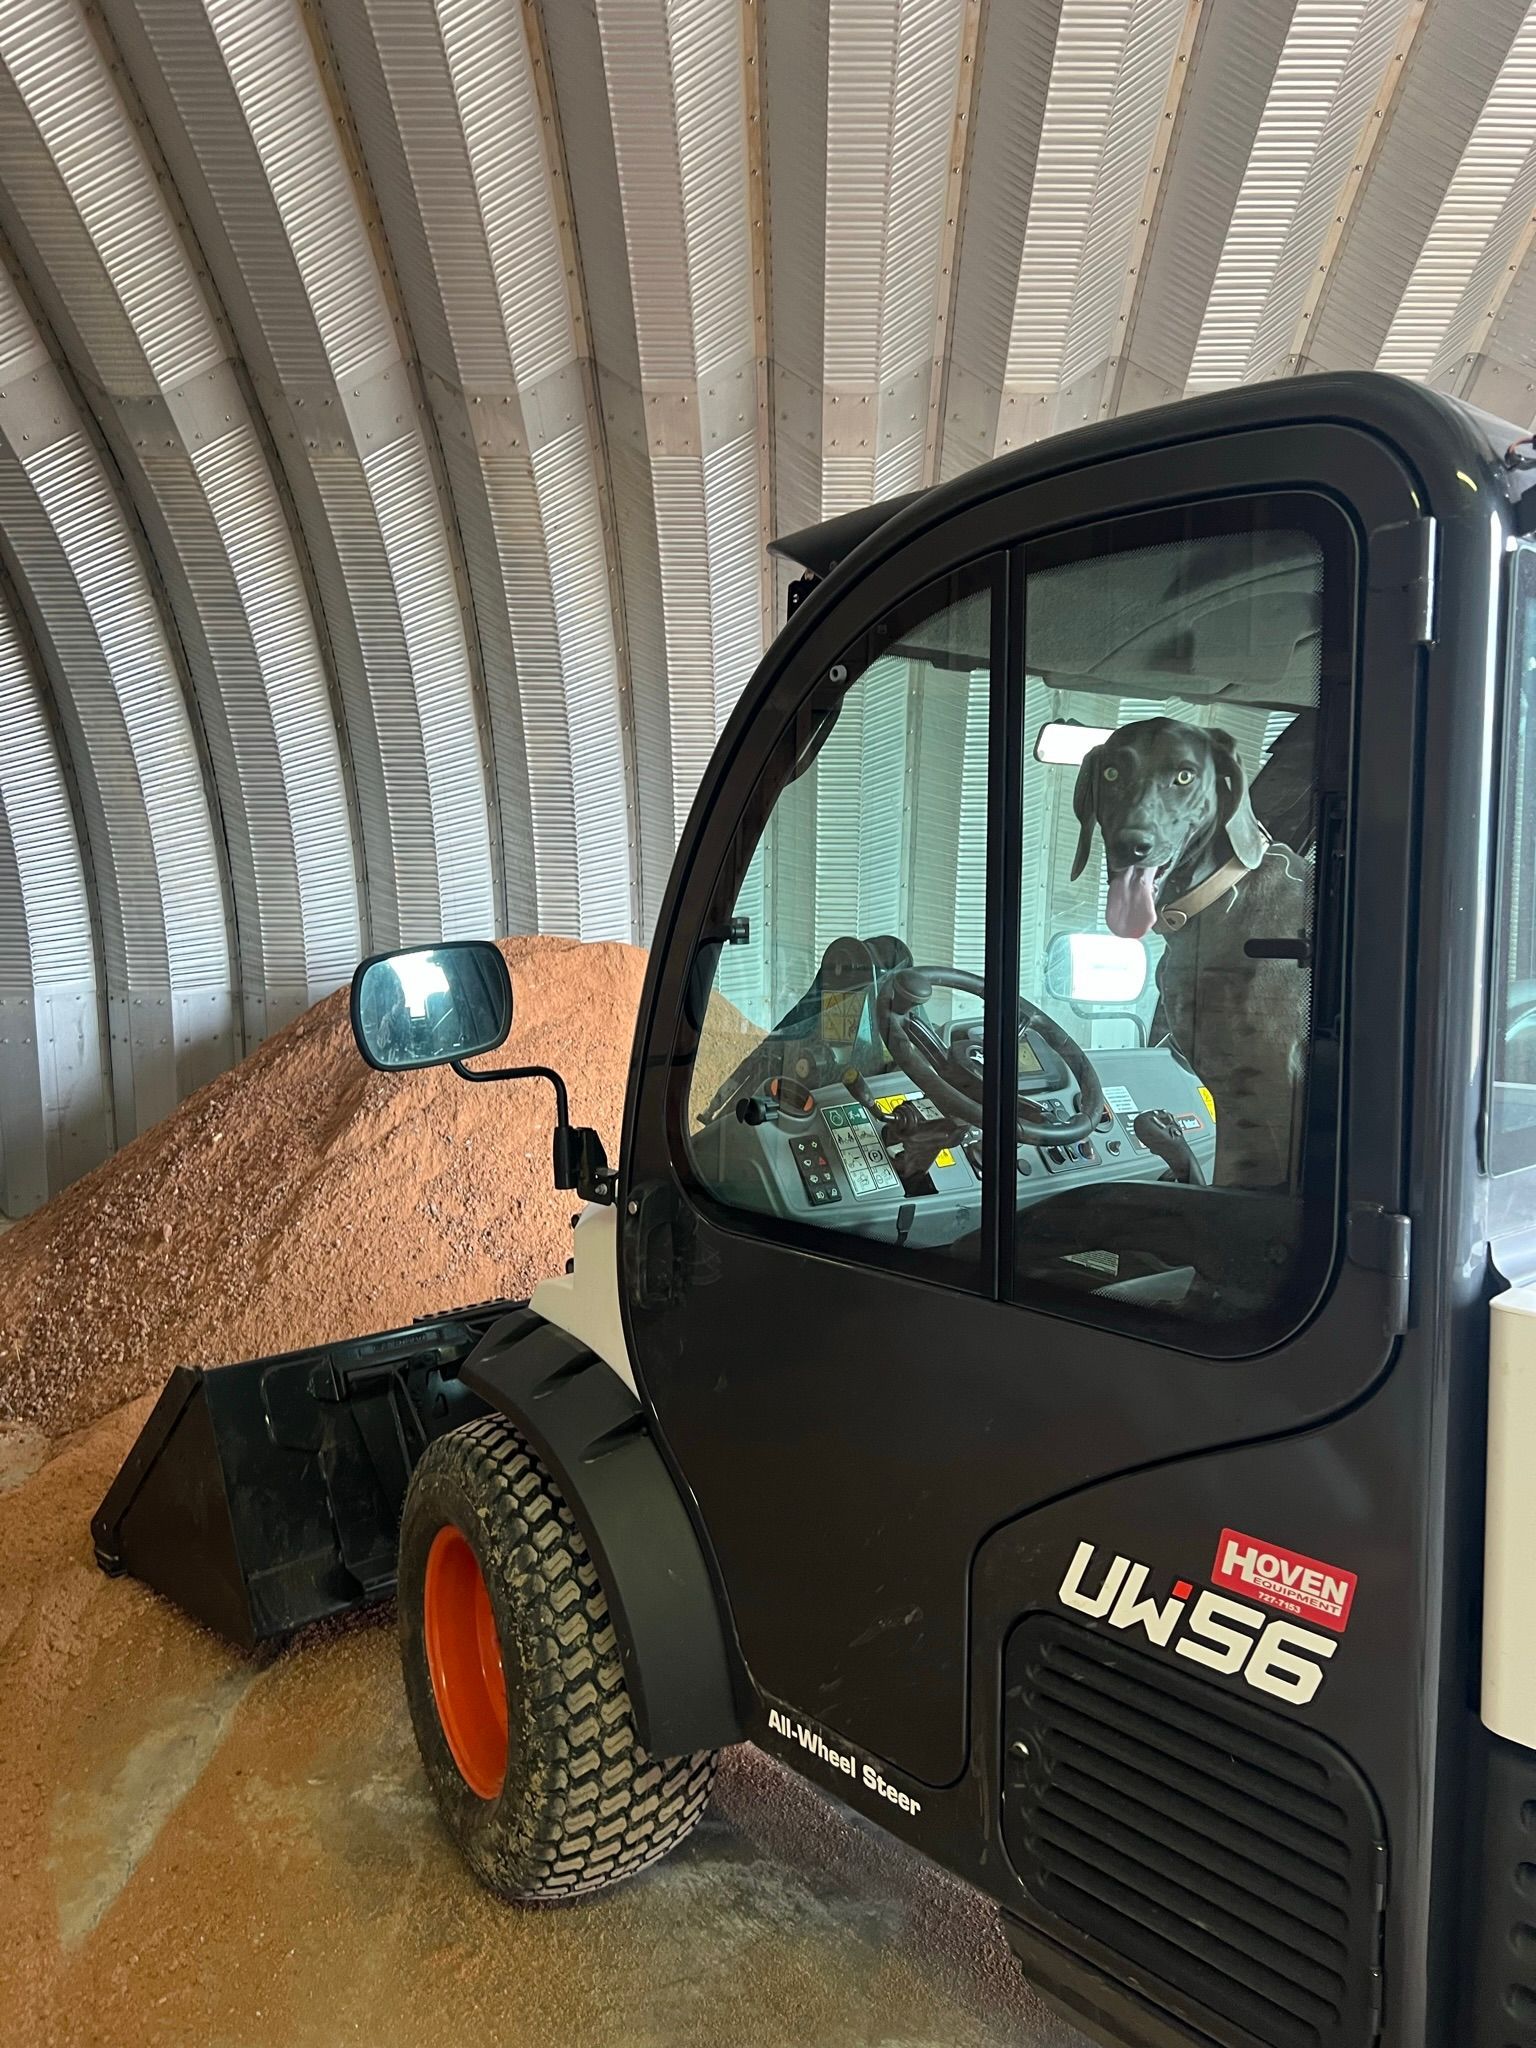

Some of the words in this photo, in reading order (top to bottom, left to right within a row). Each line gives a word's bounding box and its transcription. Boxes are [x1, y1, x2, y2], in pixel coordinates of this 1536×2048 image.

[1221, 1540, 1349, 1605] HOVEN
[1253, 1577, 1340, 1614] EQUIPMENT
[1058, 1541, 1338, 1705] UW56
[768, 1709, 856, 1778] All-Wheel
[862, 1764, 921, 1816] Steer
